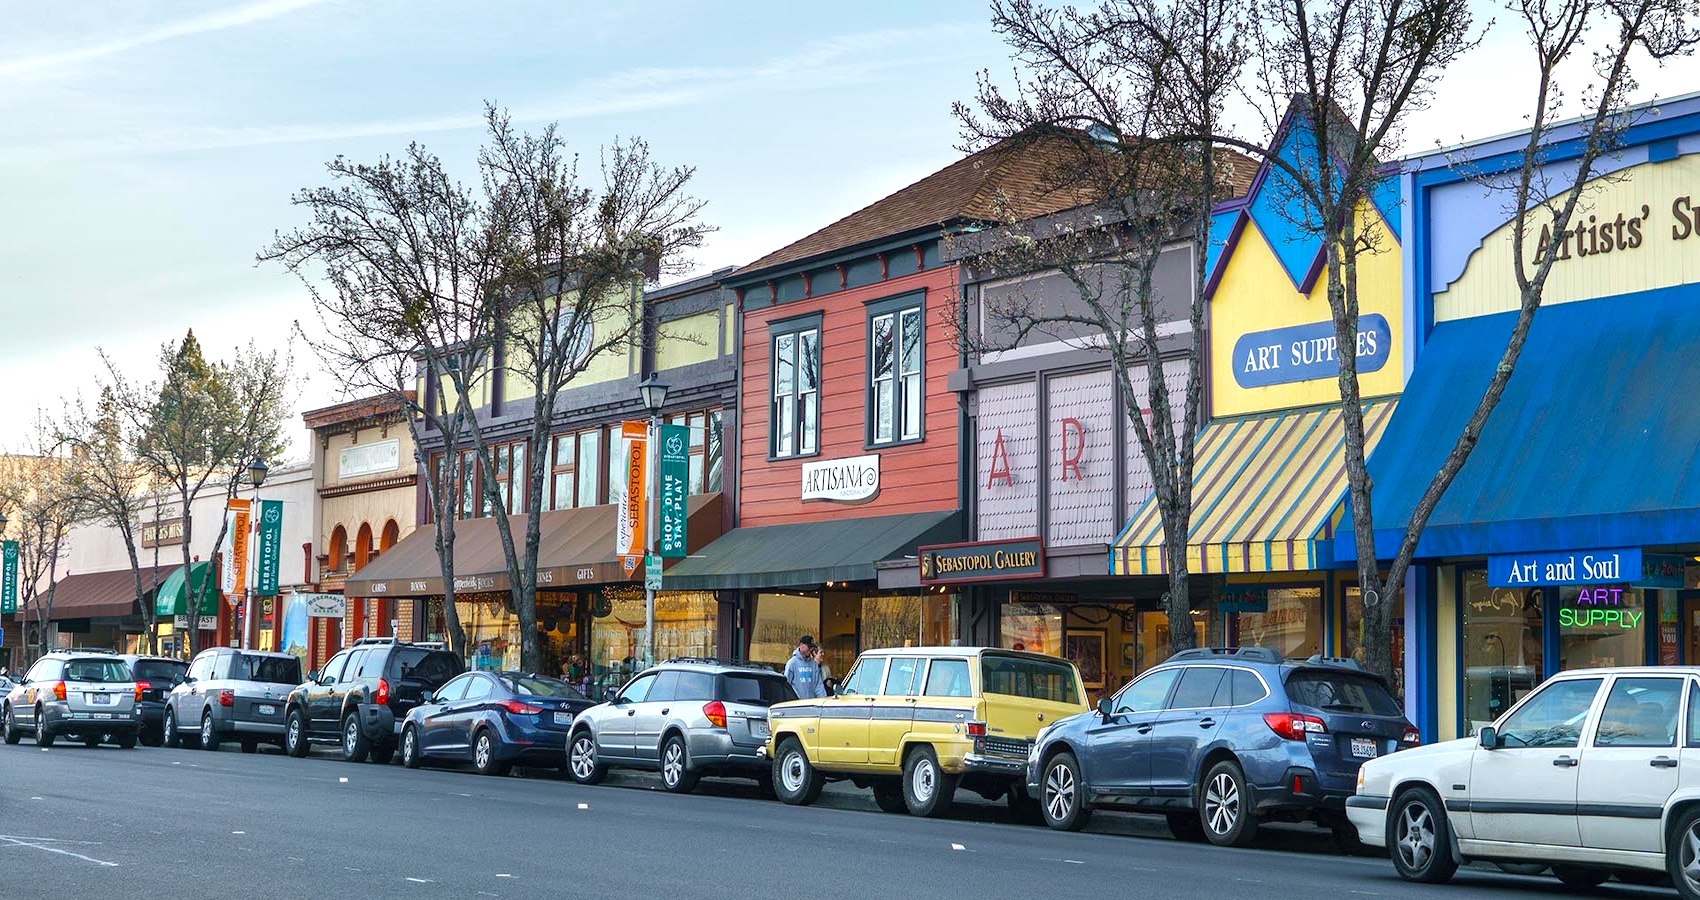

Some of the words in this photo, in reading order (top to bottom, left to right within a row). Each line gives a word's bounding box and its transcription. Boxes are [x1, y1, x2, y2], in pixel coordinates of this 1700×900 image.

[1532, 204, 1650, 265] Artists'
[1244, 344, 1282, 373] ART
[1291, 330, 1377, 366] SUPPES
[629, 442, 642, 528] SEBASTOPOL
[664, 474, 673, 505] DINE
[674, 478, 683, 510] PLAY
[804, 464, 876, 493] ARTISANA
[620, 490, 630, 547] experience
[234, 513, 245, 576] SEBASTOPOL
[262, 528, 272, 591] SEBASTOPOL
[936, 555, 992, 574] SEBASTOPOL
[994, 550, 1036, 570] GALLERY
[1508, 560, 1538, 583] Art
[1545, 556, 1575, 581] and
[1583, 554, 1620, 580] Soul
[4, 562, 12, 610] SEBASTOPOL
[371, 583, 387, 593] CARDS
[410, 581, 427, 592] BOOKS
[576, 567, 594, 580] GIFTS
[1577, 588, 1623, 606] ART
[1559, 608, 1643, 628] SUPPLY
[1662, 633, 1677, 644] YOU
